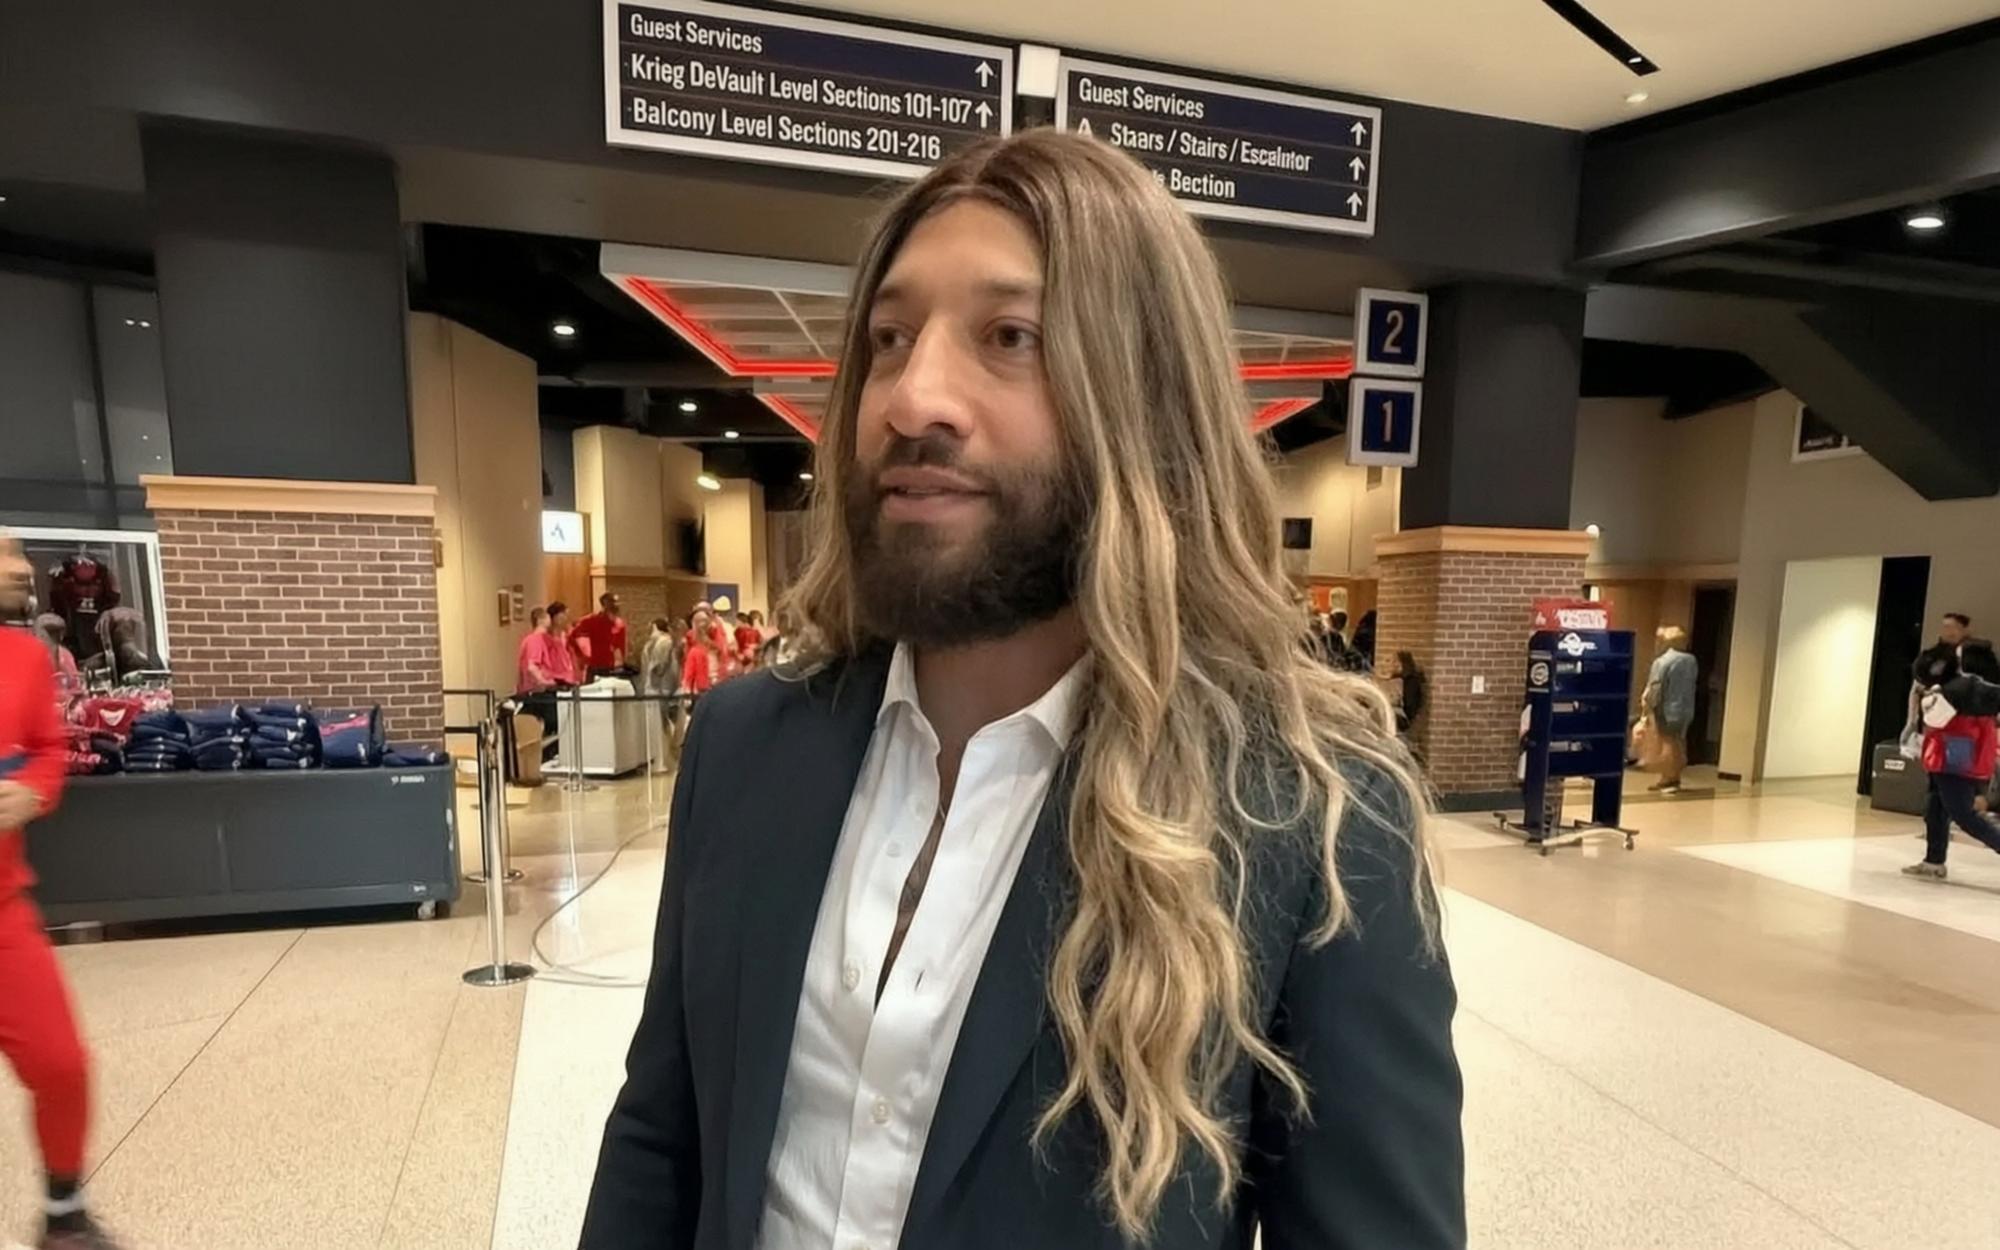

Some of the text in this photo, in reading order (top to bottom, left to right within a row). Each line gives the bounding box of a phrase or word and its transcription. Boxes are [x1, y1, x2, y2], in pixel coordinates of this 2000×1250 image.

[630, 13, 763, 53] Guest Services
[631, 53, 972, 124] Krieg DeVault Level Sections 101-107
[1079, 77, 1204, 119] Guest Services
[633, 97, 941, 160] Balcony Level Sections 201-216
[1180, 131, 1228, 160] Stairs
[1170, 168, 1236, 199] Bection
[1382, 309, 1404, 354] 2
[1382, 399, 1394, 443] 1
